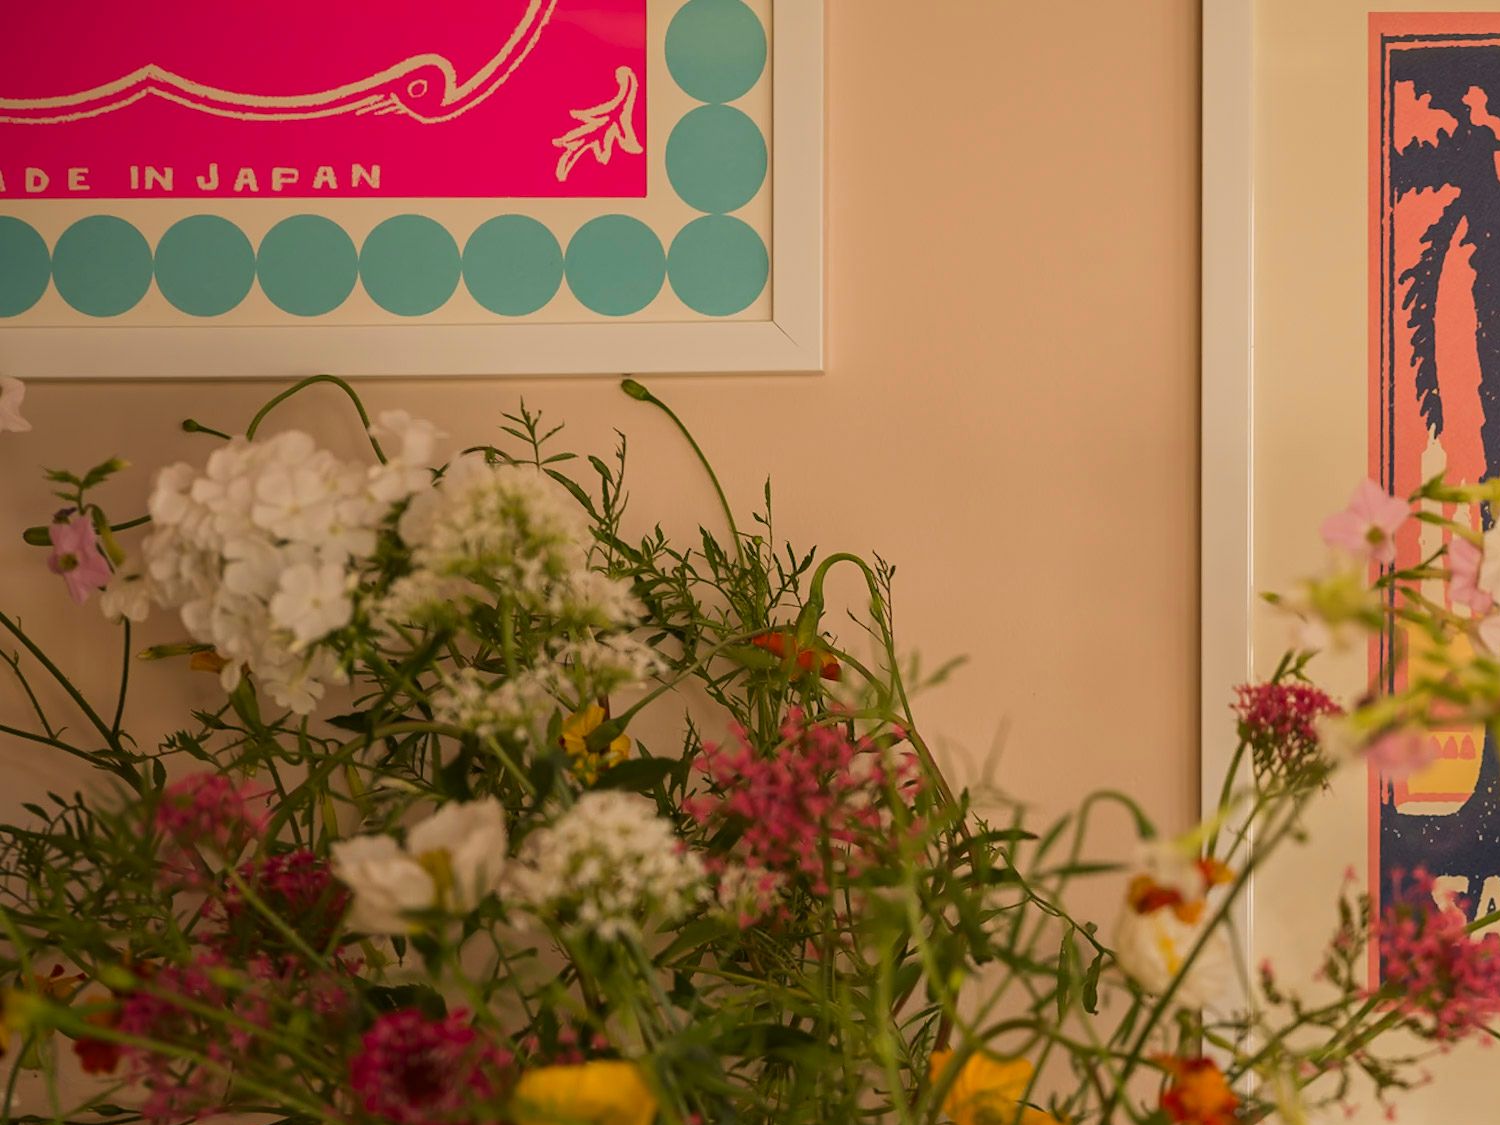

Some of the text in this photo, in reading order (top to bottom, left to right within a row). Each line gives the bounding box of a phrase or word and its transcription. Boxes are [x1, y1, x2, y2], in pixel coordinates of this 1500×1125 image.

[0, 163, 380, 193] DE IN JAPAN
